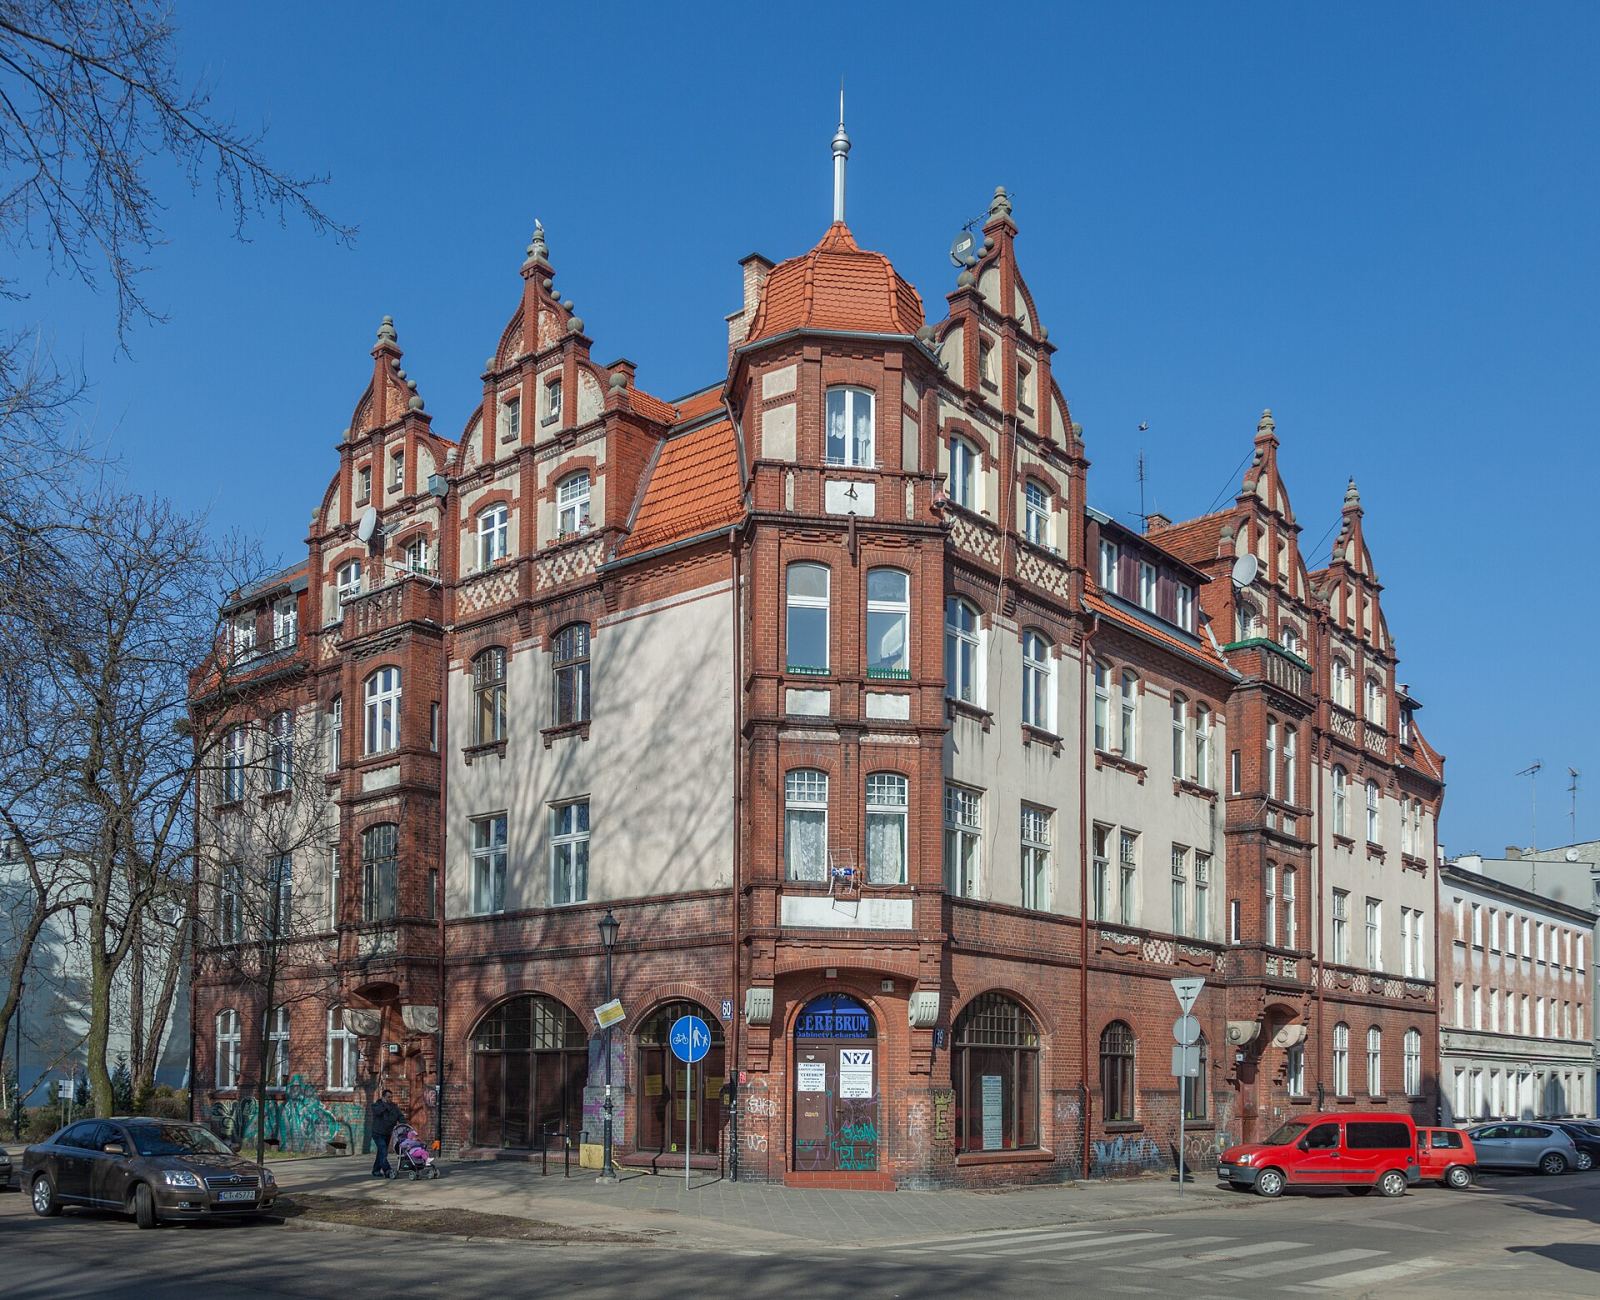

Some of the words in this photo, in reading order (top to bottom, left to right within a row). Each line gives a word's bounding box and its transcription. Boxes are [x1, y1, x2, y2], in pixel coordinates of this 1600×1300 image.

[722, 1002, 731, 1016] 60
[797, 1015, 869, 1031] CEREBRUM
[842, 1052, 870, 1064] NFZ
